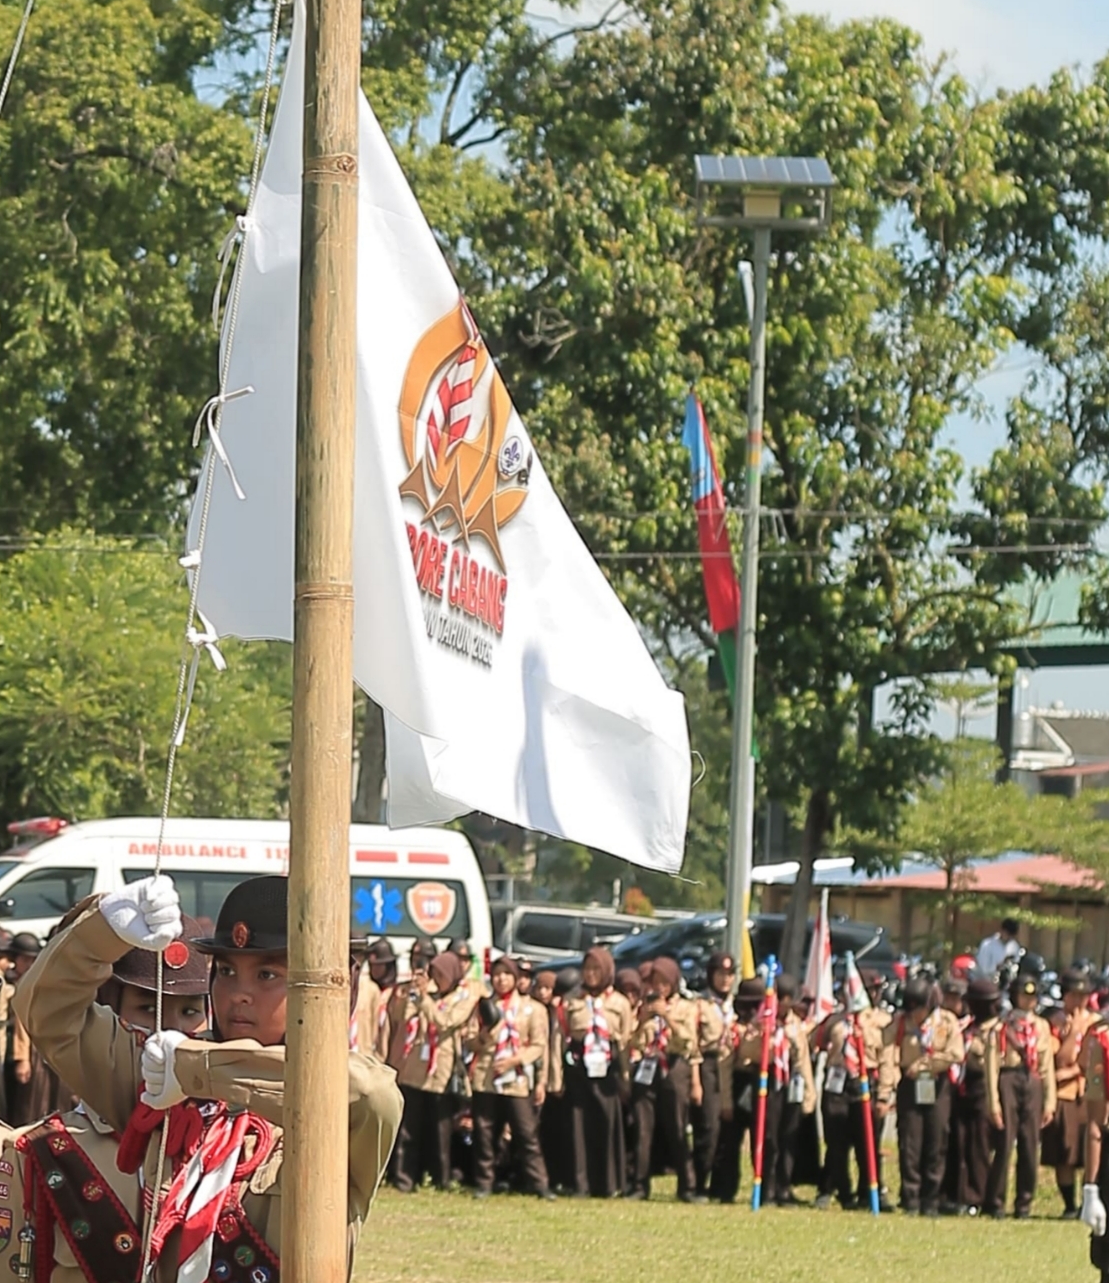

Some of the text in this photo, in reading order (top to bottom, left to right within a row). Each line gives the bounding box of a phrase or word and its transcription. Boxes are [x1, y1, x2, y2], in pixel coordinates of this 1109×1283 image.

[448, 549, 507, 634] CABANG
[438, 614, 472, 655] TAHUN
[128, 842, 247, 859] AMBULANCE
